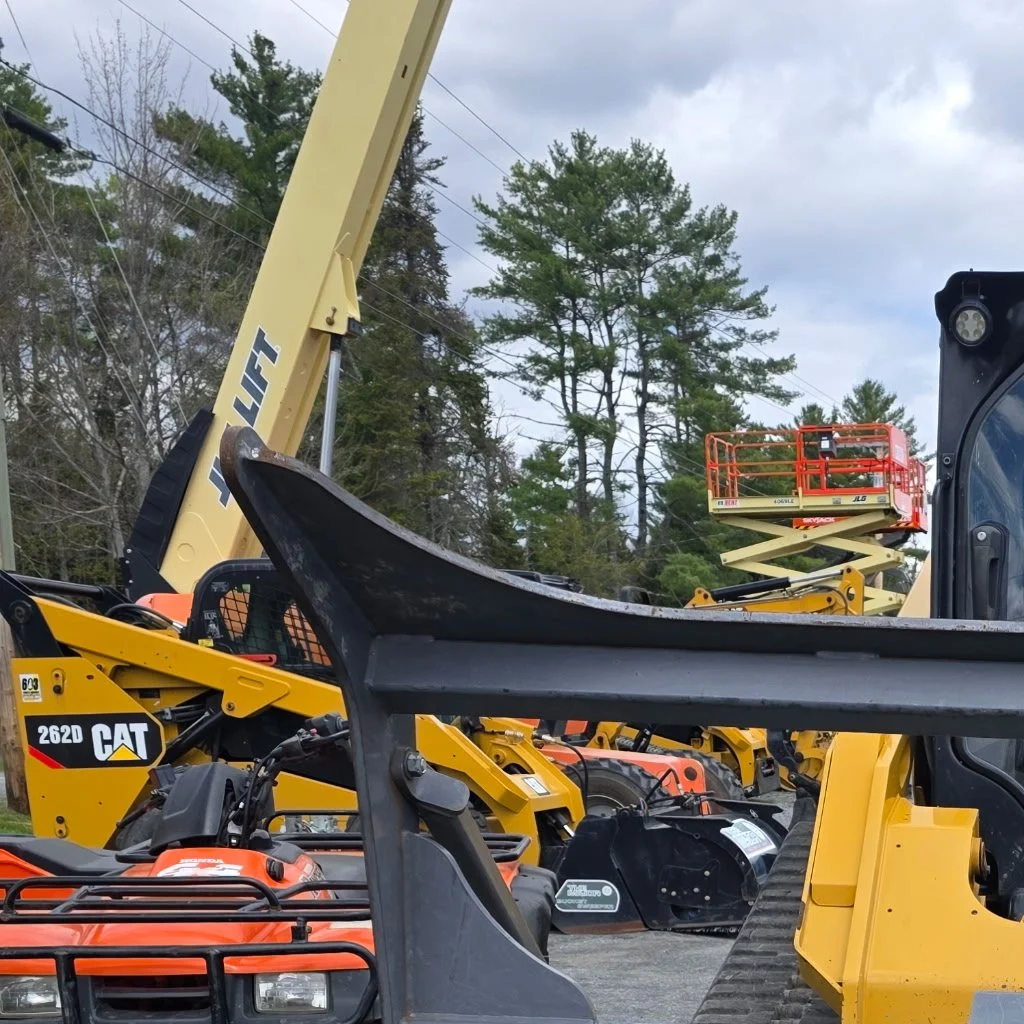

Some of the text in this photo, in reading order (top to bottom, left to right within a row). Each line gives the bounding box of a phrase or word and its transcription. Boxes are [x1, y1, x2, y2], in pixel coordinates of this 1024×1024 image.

[233, 326, 279, 428] LIFT
[852, 495, 867, 503] JLG
[37, 722, 149, 762] 262D CAT
